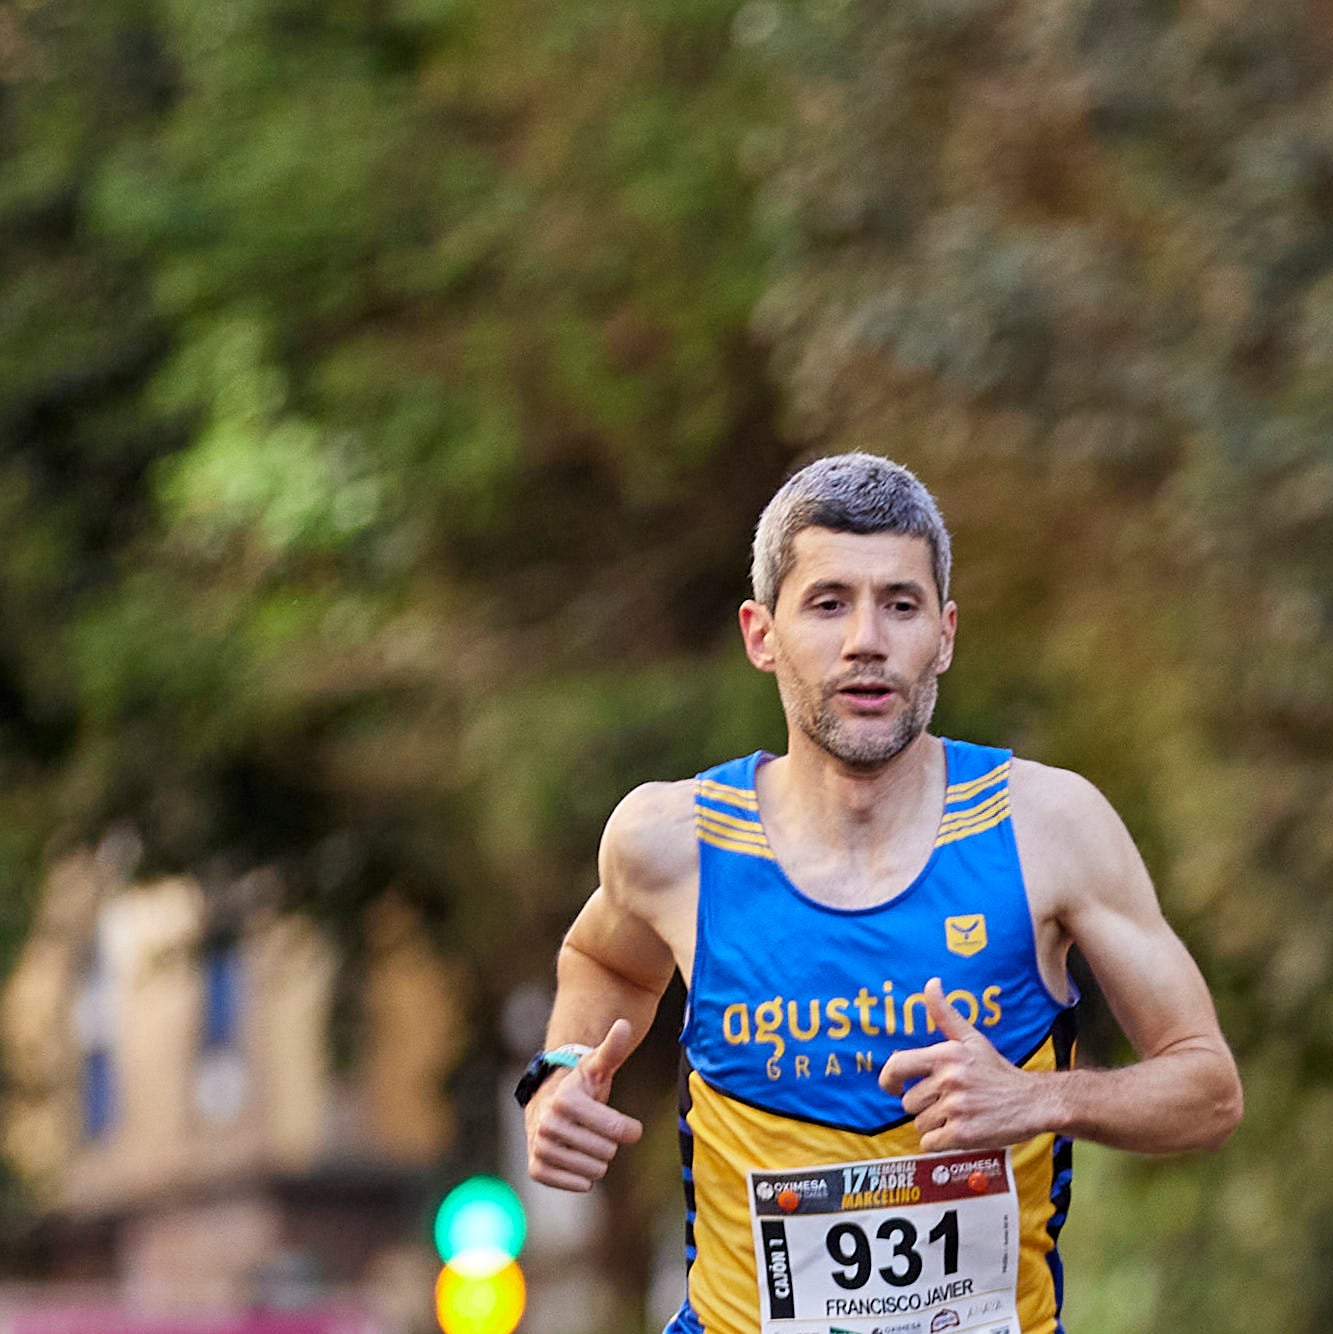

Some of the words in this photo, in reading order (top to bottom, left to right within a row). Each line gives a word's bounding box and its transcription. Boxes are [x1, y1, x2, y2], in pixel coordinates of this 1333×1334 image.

[723, 979, 1002, 1058] agustinos
[767, 1049, 874, 1081] GRAN
[949, 1158, 1000, 1174] OXIMESA
[773, 1178, 828, 1192] OXIMESA
[842, 1167, 868, 1195] 17
[869, 1171, 915, 1192] PADRE
[841, 1186, 921, 1210] MARCELINO
[825, 1209, 959, 1291] 931
[826, 1293, 922, 1316] FRANCISCO
[924, 1278, 974, 1307] JAVIER
